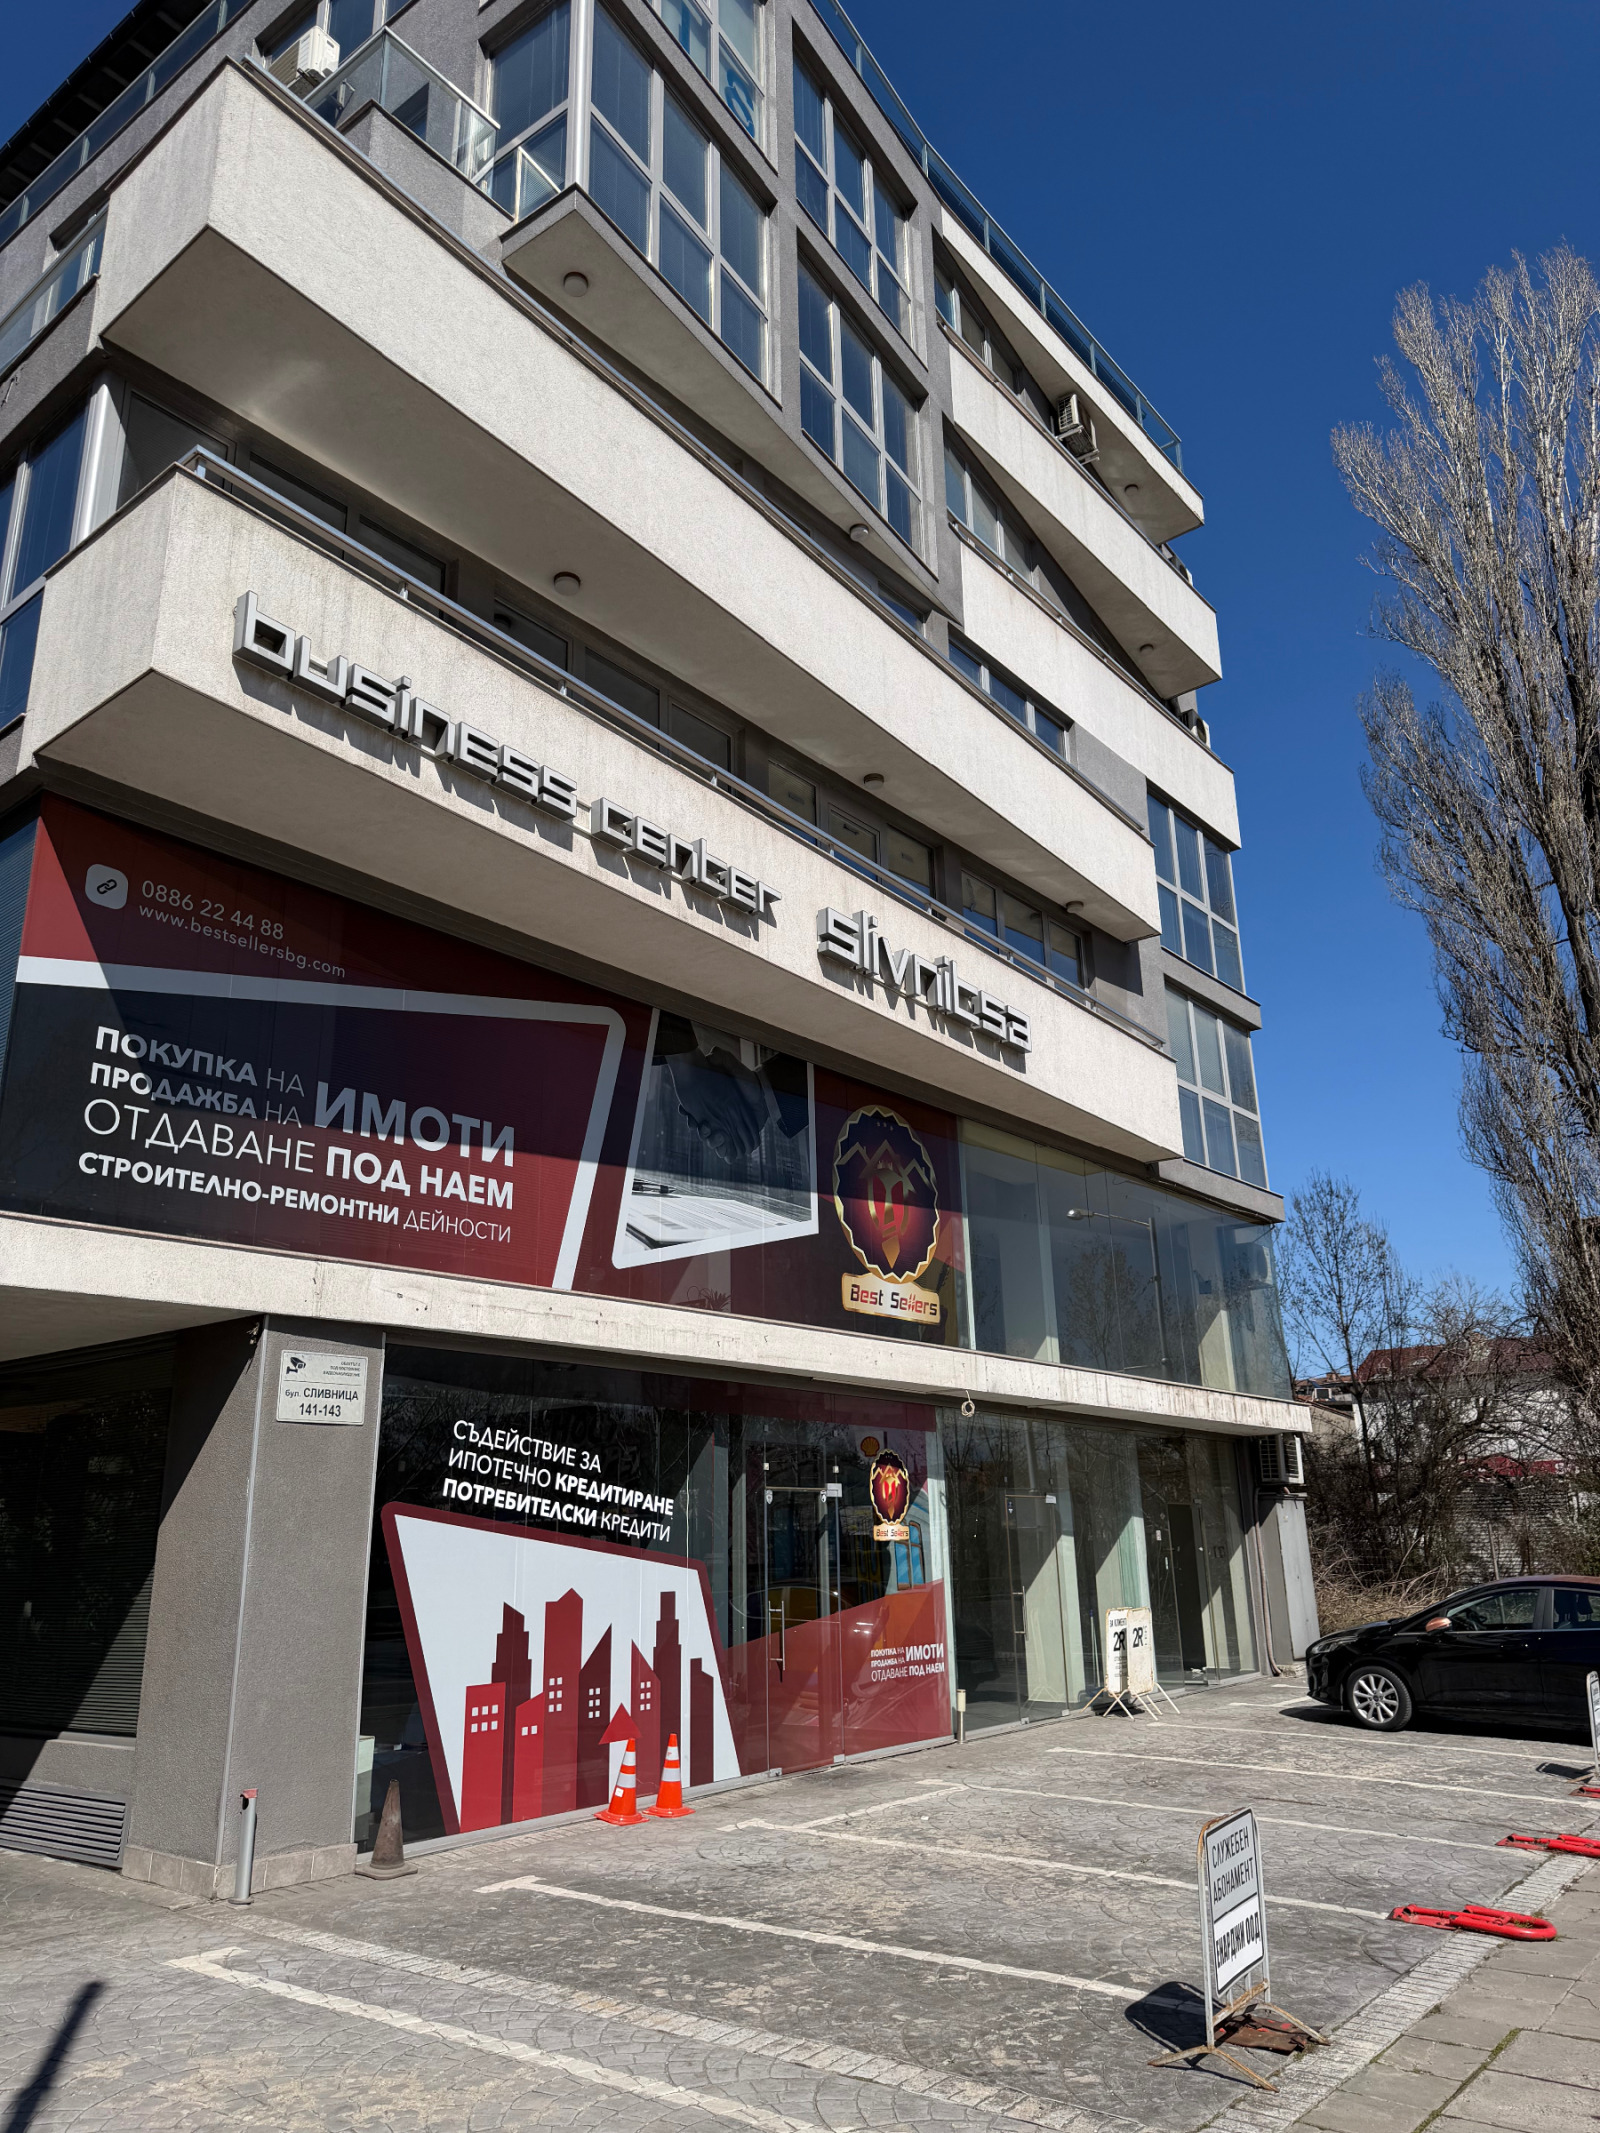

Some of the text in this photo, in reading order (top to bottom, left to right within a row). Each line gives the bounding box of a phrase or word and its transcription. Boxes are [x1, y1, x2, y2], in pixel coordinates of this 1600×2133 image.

[142, 880, 284, 940] 0886 22 44 88
[139, 904, 346, 978] www.bestsellersbg.com
[816, 907, 1032, 1053] slivnitsa
[96, 1025, 305, 1097] ПОКУПКА НА
[90, 1062, 302, 1129] ПРОДАЖБА НА
[315, 1081, 515, 1167] ИМОТИ
[84, 1098, 514, 1210] ОТДАВАНЕ ПОД НАЕМ
[78, 1151, 512, 1243] СТРОИТЕЛНО-РЕМОНТНИ ДЕЙНОСТИ
[850, 1284, 937, 1316] Best Sellers
[285, 1388, 359, 1402] бул. СЛИВНИЦА
[299, 1403, 341, 1417] 141-143
[453, 1420, 577, 1467] СЪДЕЙСТВИЕ
[580, 1451, 602, 1473] ЗА
[442, 1478, 671, 1542] ПОТРЕБИТЕЛСКИ КРЕДИТИ
[448, 1448, 674, 1516] ИПОТЕЧНО КРЕДИТИРАНЕ
[871, 1646, 905, 1657] ПОКУПКА НА
[871, 1656, 906, 1668] ПРОДАЖБА НА
[871, 1662, 945, 1682] ОТДАВАНЕ ПОД НАЕМ
[905, 1643, 944, 1661] ИМОТИ
[1211, 1825, 1250, 1869] СЛУЖЕБЕН
[1213, 1857, 1254, 1905] АБОНАМЕНТ
